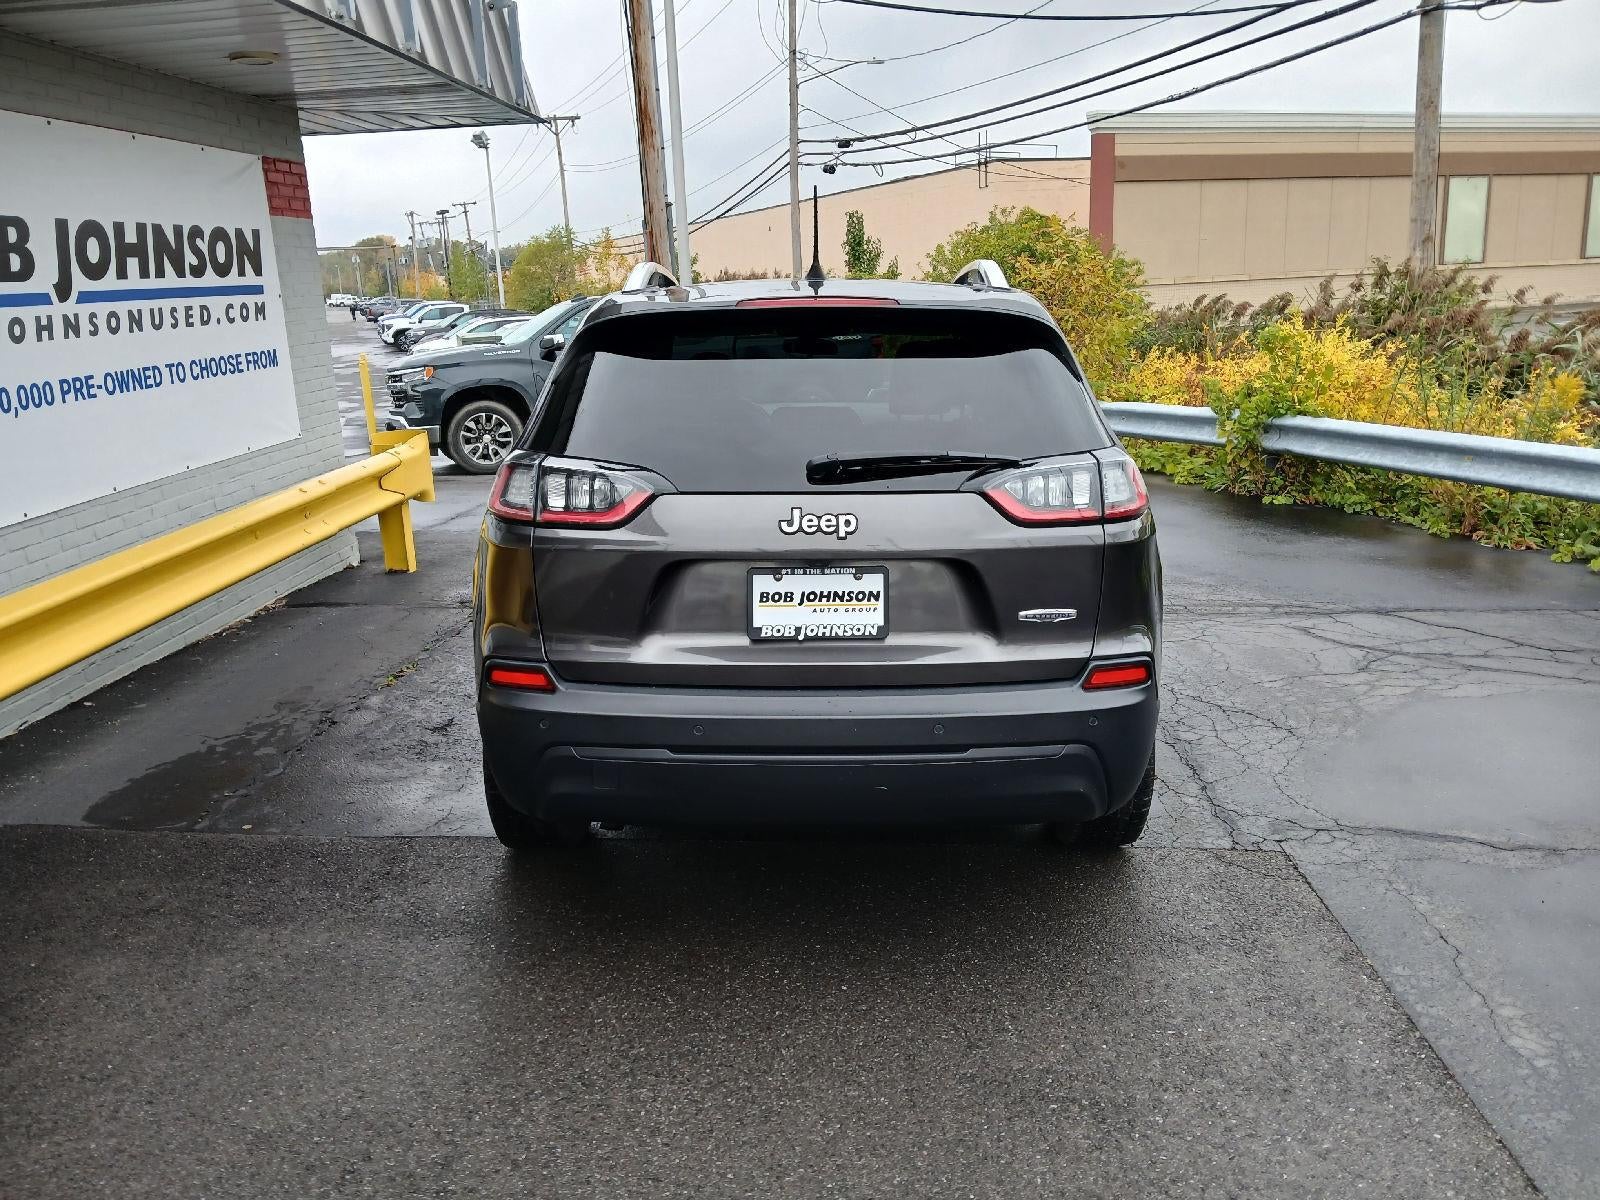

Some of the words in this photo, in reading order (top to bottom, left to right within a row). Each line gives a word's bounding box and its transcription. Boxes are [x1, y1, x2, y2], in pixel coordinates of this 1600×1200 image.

[52, 217, 264, 303] JOHNSON
[7, 301, 267, 345] OHNSONUSED.COM
[0, 381, 55, 418] 0,000
[58, 364, 163, 404] PRE-OWNED
[165, 360, 187, 385] TO
[189, 353, 243, 380] CHOOSE
[244, 348, 279, 372] FROM
[778, 507, 858, 540] Jeep
[824, 567, 856, 575] NATION
[759, 591, 795, 603] BOB
[798, 590, 881, 606] JOHNSON
[760, 624, 796, 637] BOB
[797, 623, 879, 640] JOHNSON
